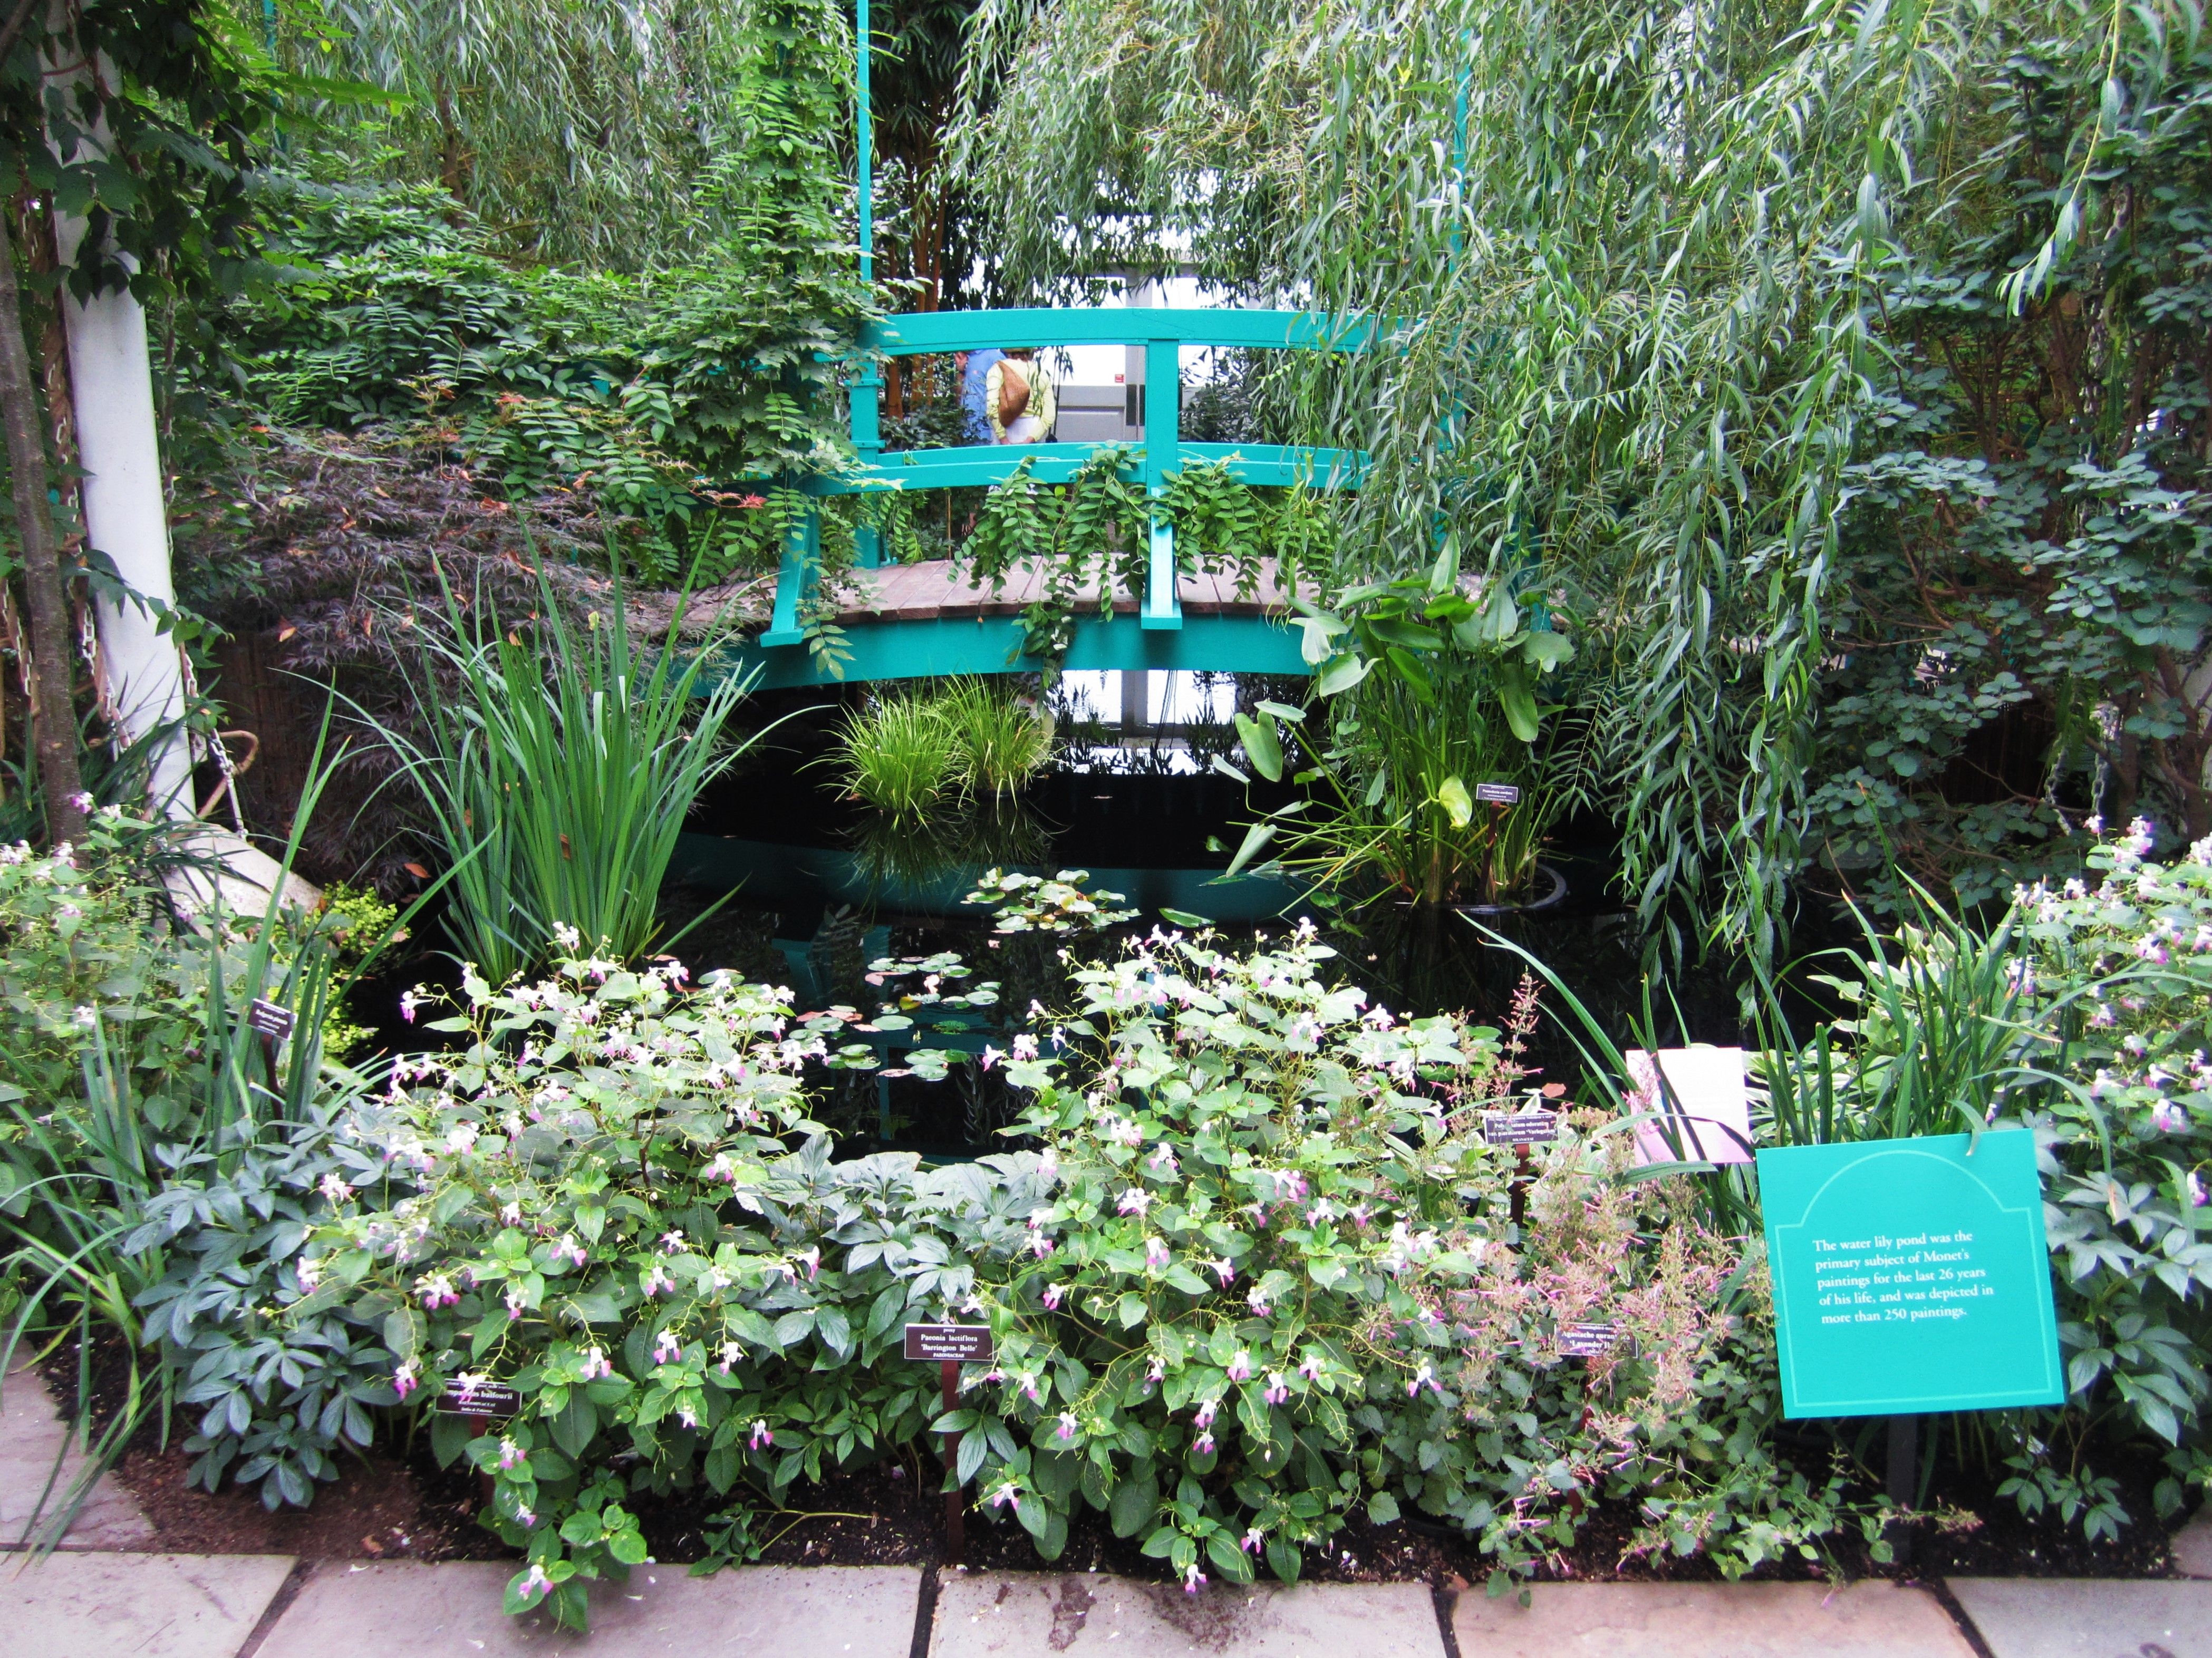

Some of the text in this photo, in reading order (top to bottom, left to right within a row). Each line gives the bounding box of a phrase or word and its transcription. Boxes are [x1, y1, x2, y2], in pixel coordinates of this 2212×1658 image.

[1812, 1229, 1973, 1252] The water lily pond was the
[1815, 1248, 1970, 1273] primary subject of Monet's
[1817, 1267, 1986, 1291] paintings for the last 26 years
[1819, 1284, 1994, 1306] of his life, and was depicted in
[1821, 1305, 1967, 1324] more than 250 paintings.
[921, 1344, 957, 1352] 'Barrington
[481, 1390, 513, 1400] balfourii
